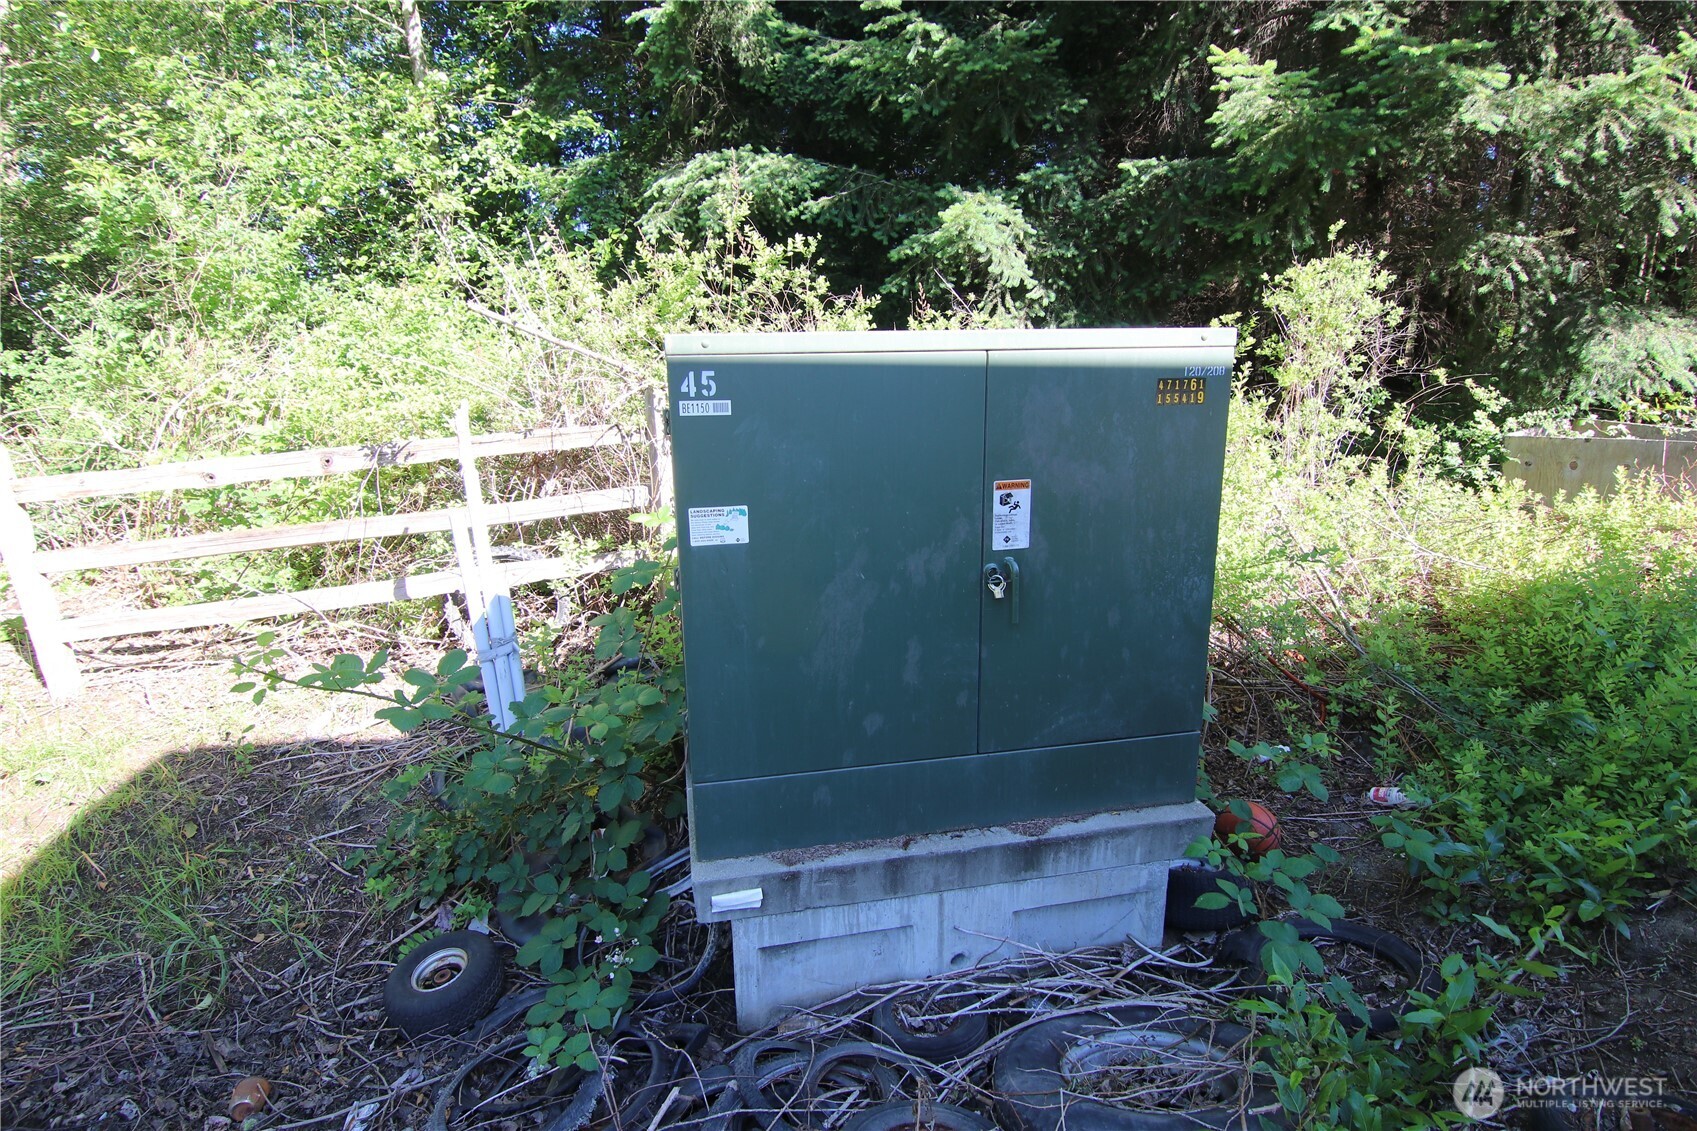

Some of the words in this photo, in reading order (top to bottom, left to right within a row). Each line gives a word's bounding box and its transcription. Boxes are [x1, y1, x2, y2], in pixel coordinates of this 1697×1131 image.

[1184, 366, 1226, 377] 120/208
[680, 370, 717, 398] 45
[1158, 378, 1204, 391] 471761
[1157, 391, 1204, 404] 155419
[681, 402, 710, 414] BE1150
[1002, 481, 1030, 490] WARNING
